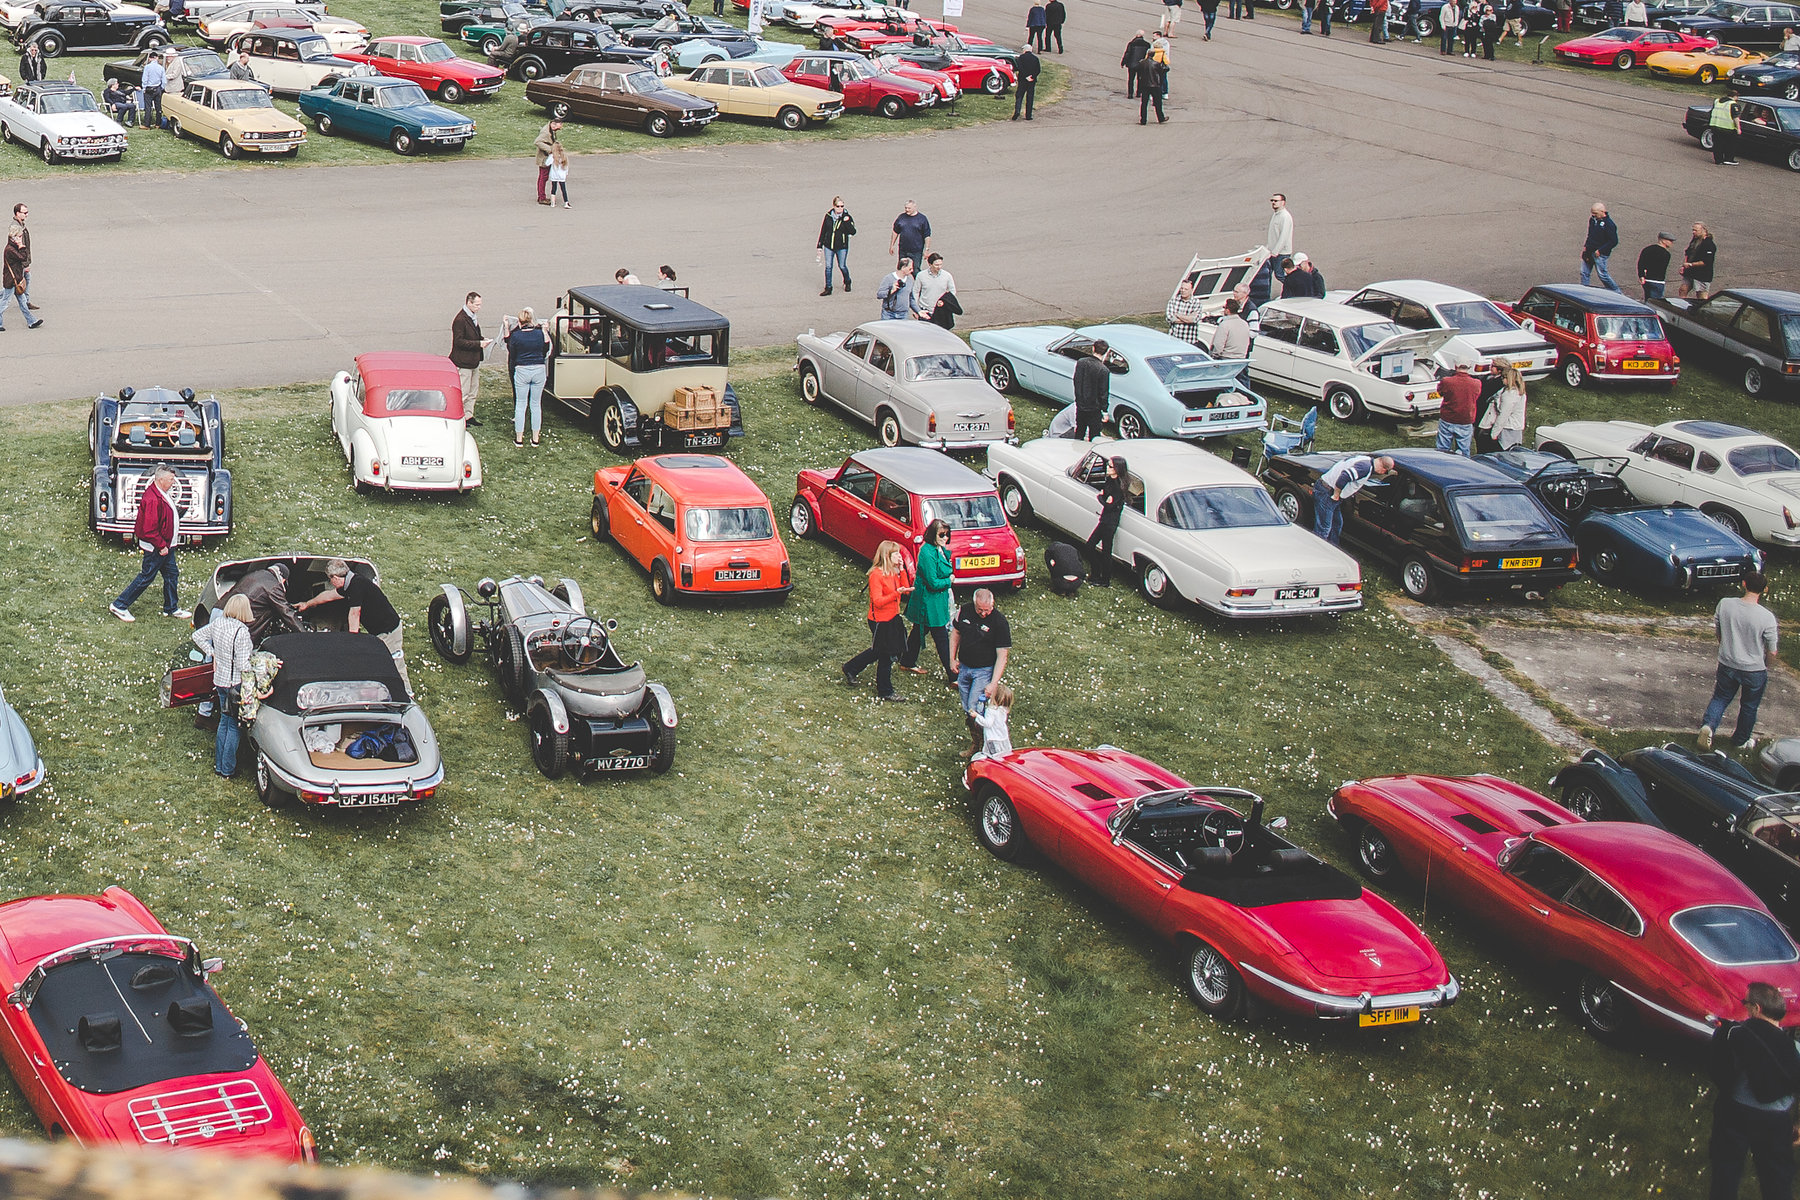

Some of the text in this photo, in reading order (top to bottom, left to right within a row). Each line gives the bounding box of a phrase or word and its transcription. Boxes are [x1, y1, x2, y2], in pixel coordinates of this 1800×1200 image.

[970, 423, 989, 431] 237A
[403, 457, 442, 466] ABH 212C
[981, 557, 996, 566] SJB
[718, 570, 735, 580] DEN
[1298, 589, 1316, 598] 94K
[597, 757, 644, 770] MV 2770
[1370, 1010, 1392, 1023] SFF
